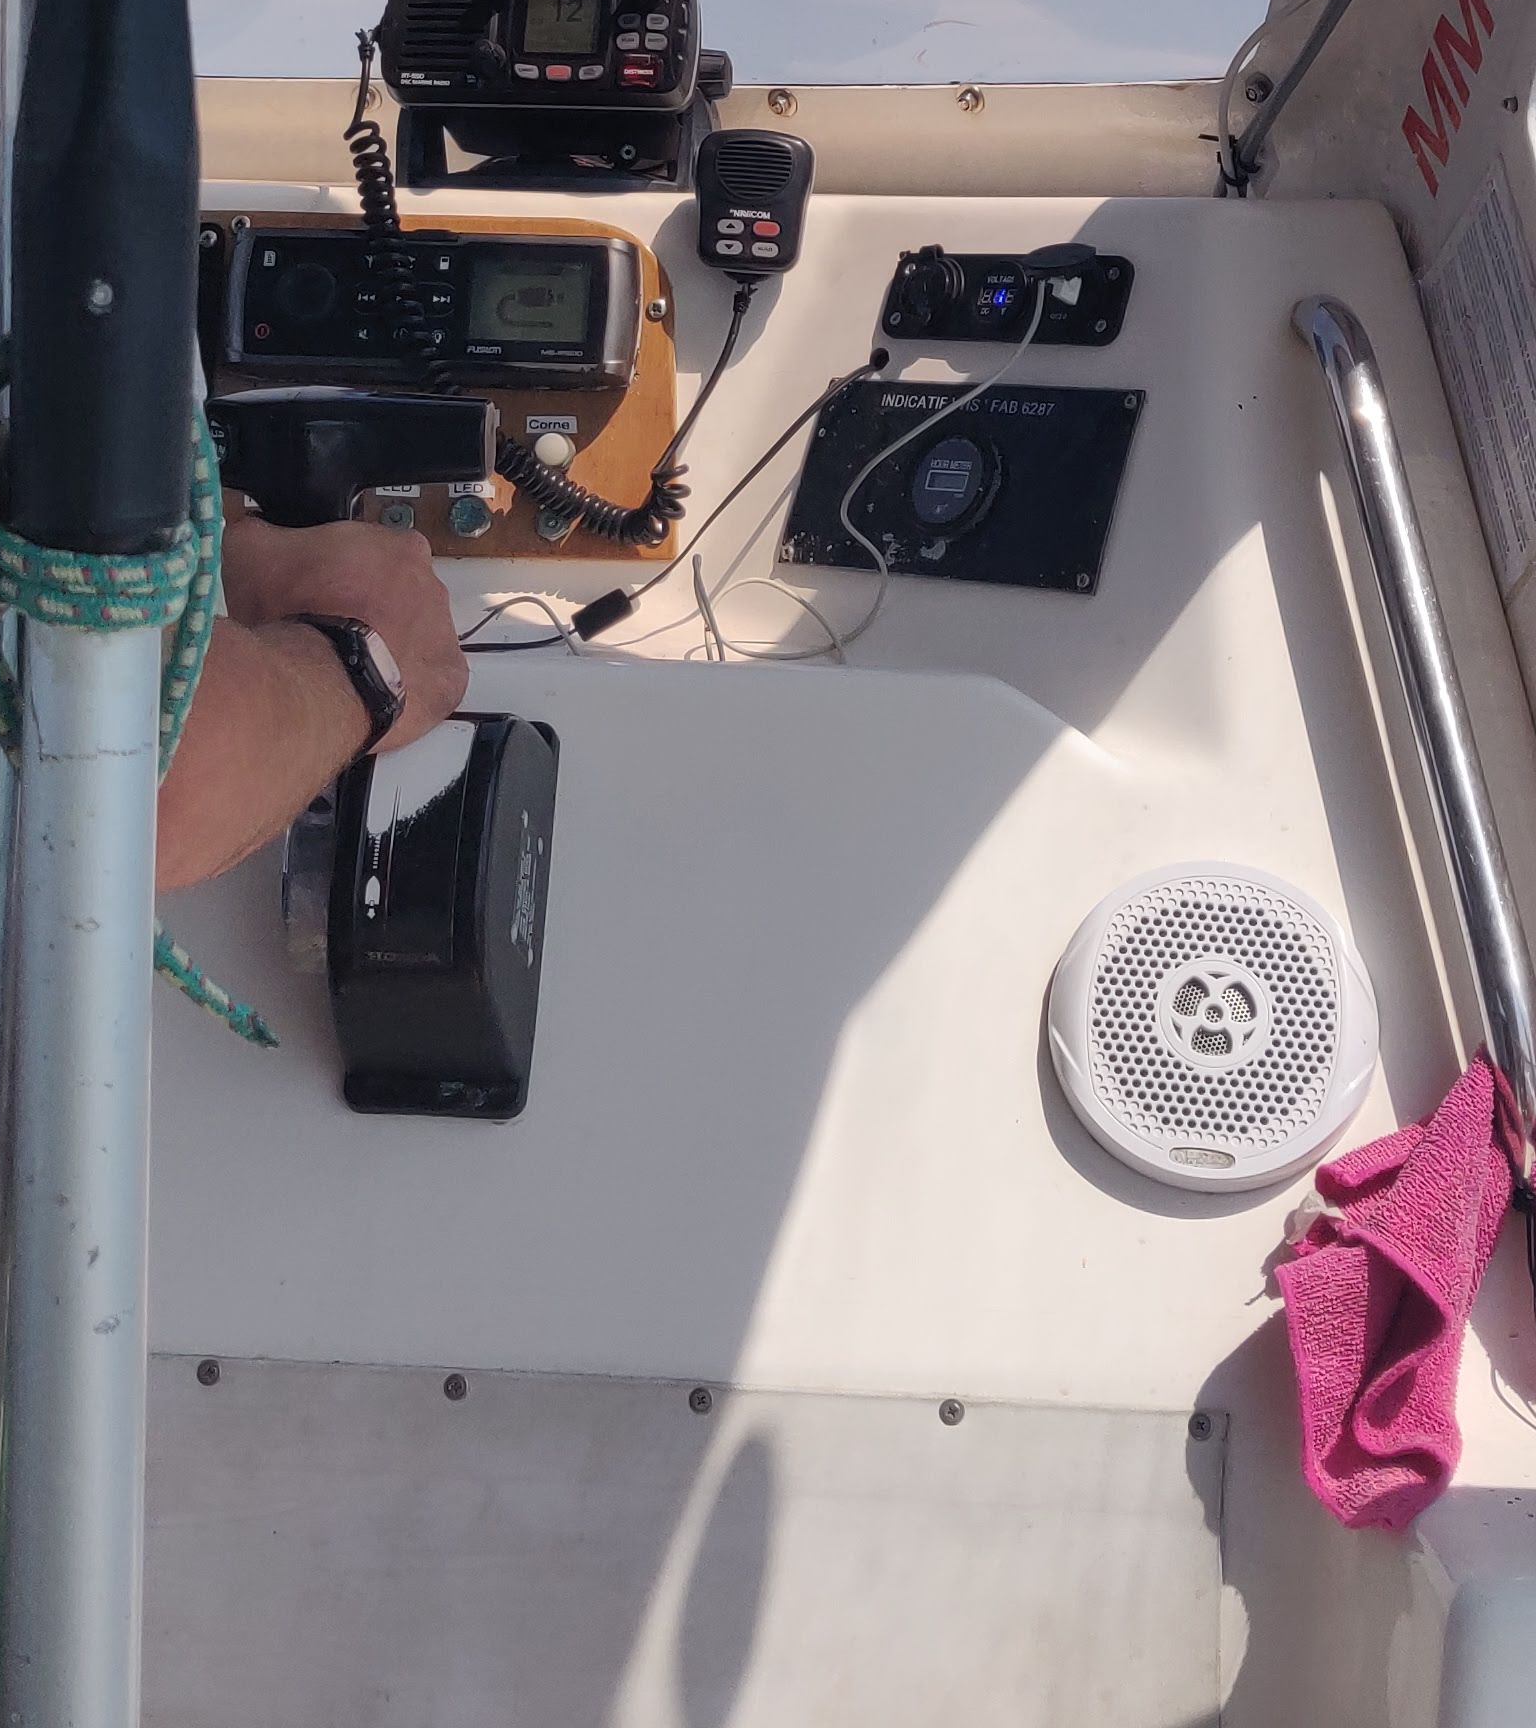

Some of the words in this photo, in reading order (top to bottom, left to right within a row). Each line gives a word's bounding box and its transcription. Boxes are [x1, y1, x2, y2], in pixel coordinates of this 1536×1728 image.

[466, 345, 502, 355] FUSION
[881, 393, 949, 410] INDICATIF
[990, 399, 1018, 415] FAB
[1021, 402, 1056, 416] 6287
[528, 419, 571, 431] Corne
[930, 459, 950, 469] HOUR
[949, 460, 973, 471] METER
[453, 482, 484, 495] LED
